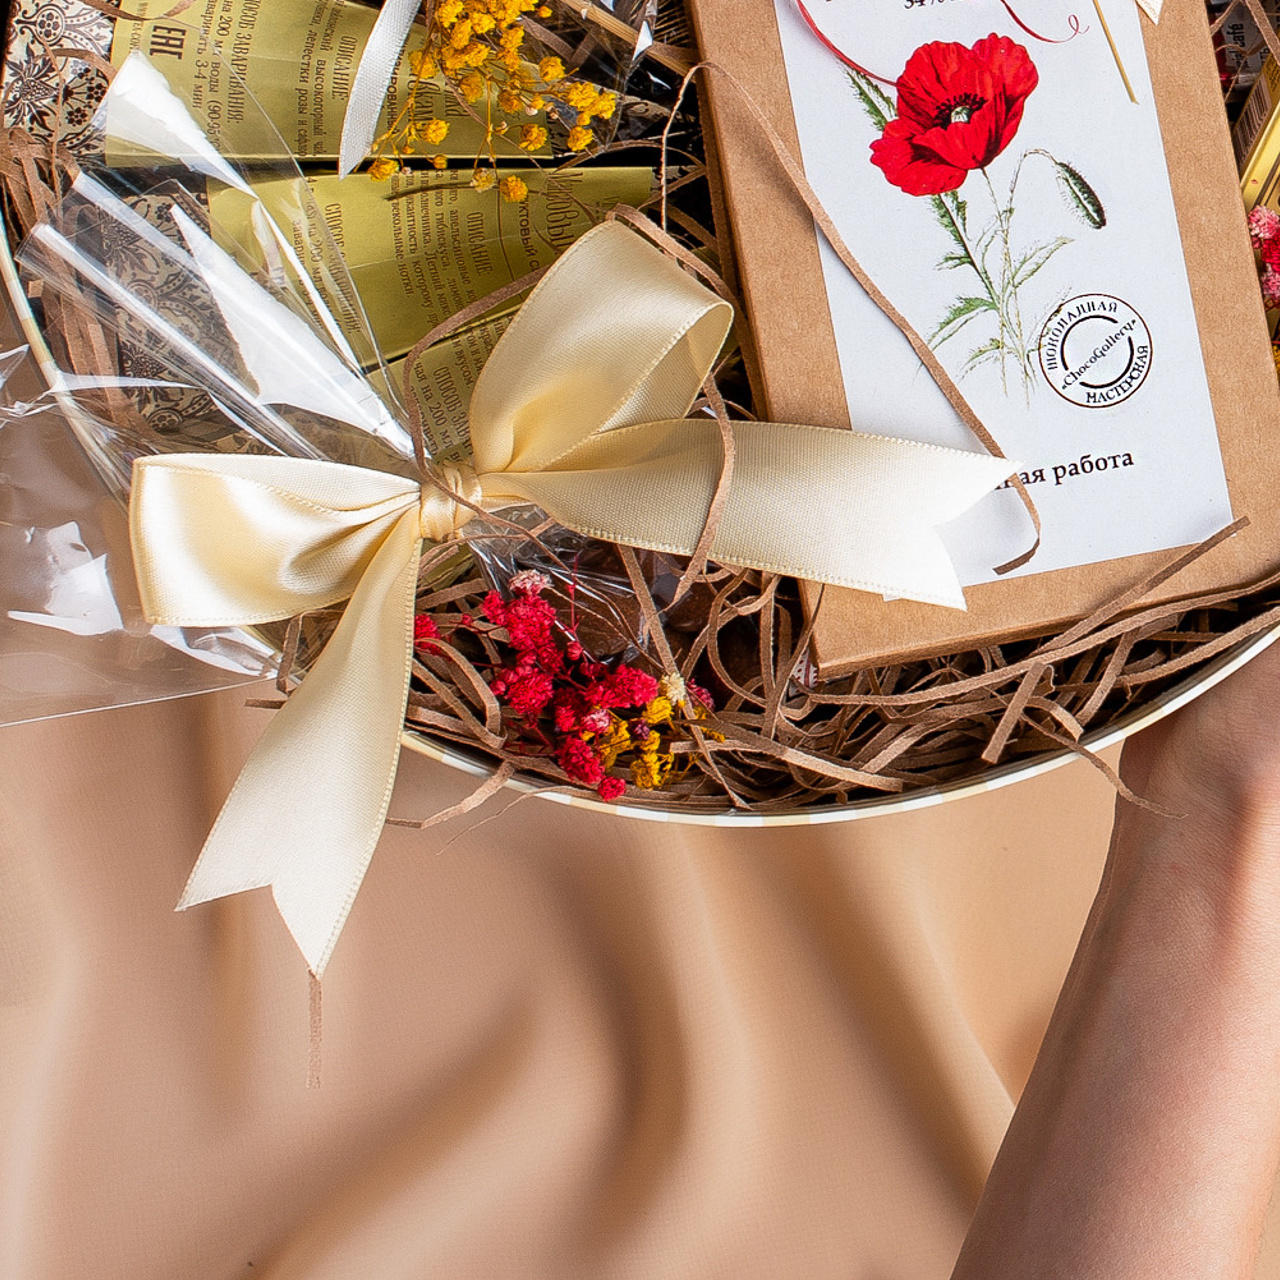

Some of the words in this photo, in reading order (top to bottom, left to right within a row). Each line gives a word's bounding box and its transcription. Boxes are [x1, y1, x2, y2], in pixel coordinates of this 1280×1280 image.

[218, 15, 233, 37] 200
[208, 61, 221, 93] воды
[227, 32, 254, 124] ЗАВАРИВАНИЯ:
[299, 29, 315, 83] лепестки
[332, 35, 360, 101] ОПИСАНИЕ:
[192, 84, 203, 109] мин
[294, 87, 308, 116] розы
[391, 202, 404, 261] векольные
[405, 195, 419, 254] икантность
[412, 259, 433, 308] которому
[466, 211, 493, 277] ОПИСАНИЕ:
[434, 366, 463, 413] СПОСОБ
[1086, 345, 1149, 403] МАСТЕРСКАЯ
[420, 384, 433, 402] на
[429, 402, 447, 426] 200
[1052, 452, 1135, 486] работа
